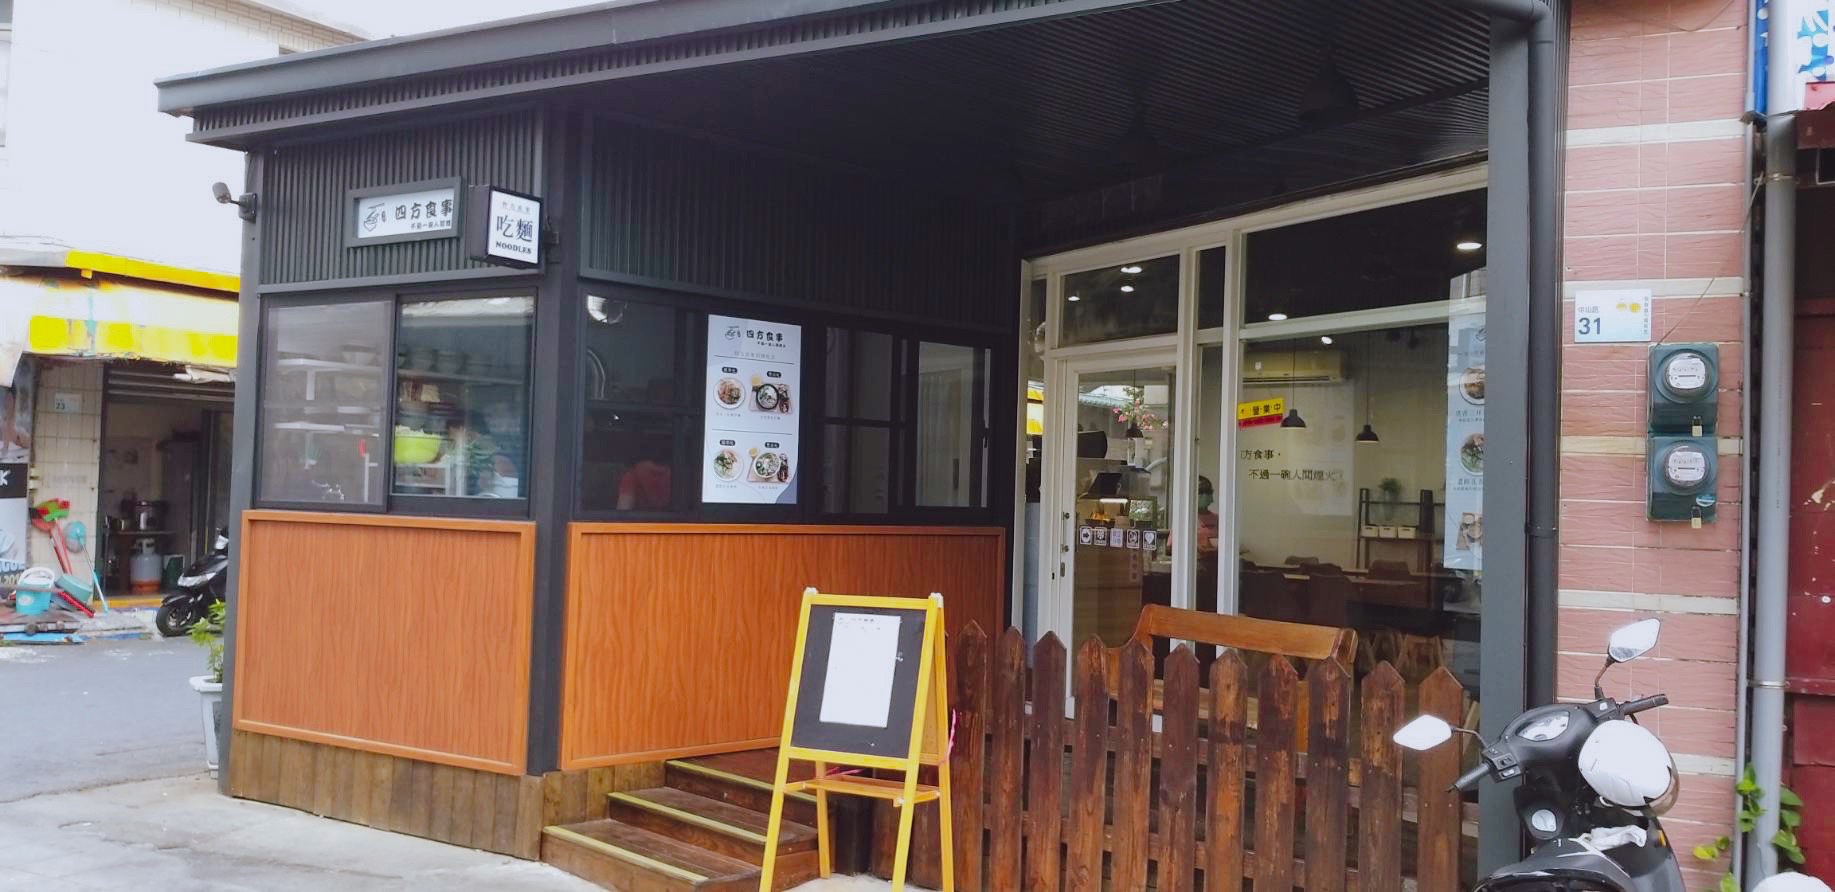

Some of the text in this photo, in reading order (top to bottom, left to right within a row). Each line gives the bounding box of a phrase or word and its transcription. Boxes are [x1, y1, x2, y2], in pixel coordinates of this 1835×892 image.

[395, 199, 453, 220] 四方食事
[496, 215, 533, 242] 吃麵
[495, 241, 532, 254] NOODLES
[1578, 317, 1601, 335] 31
[1252, 402, 1282, 416] 營業中
